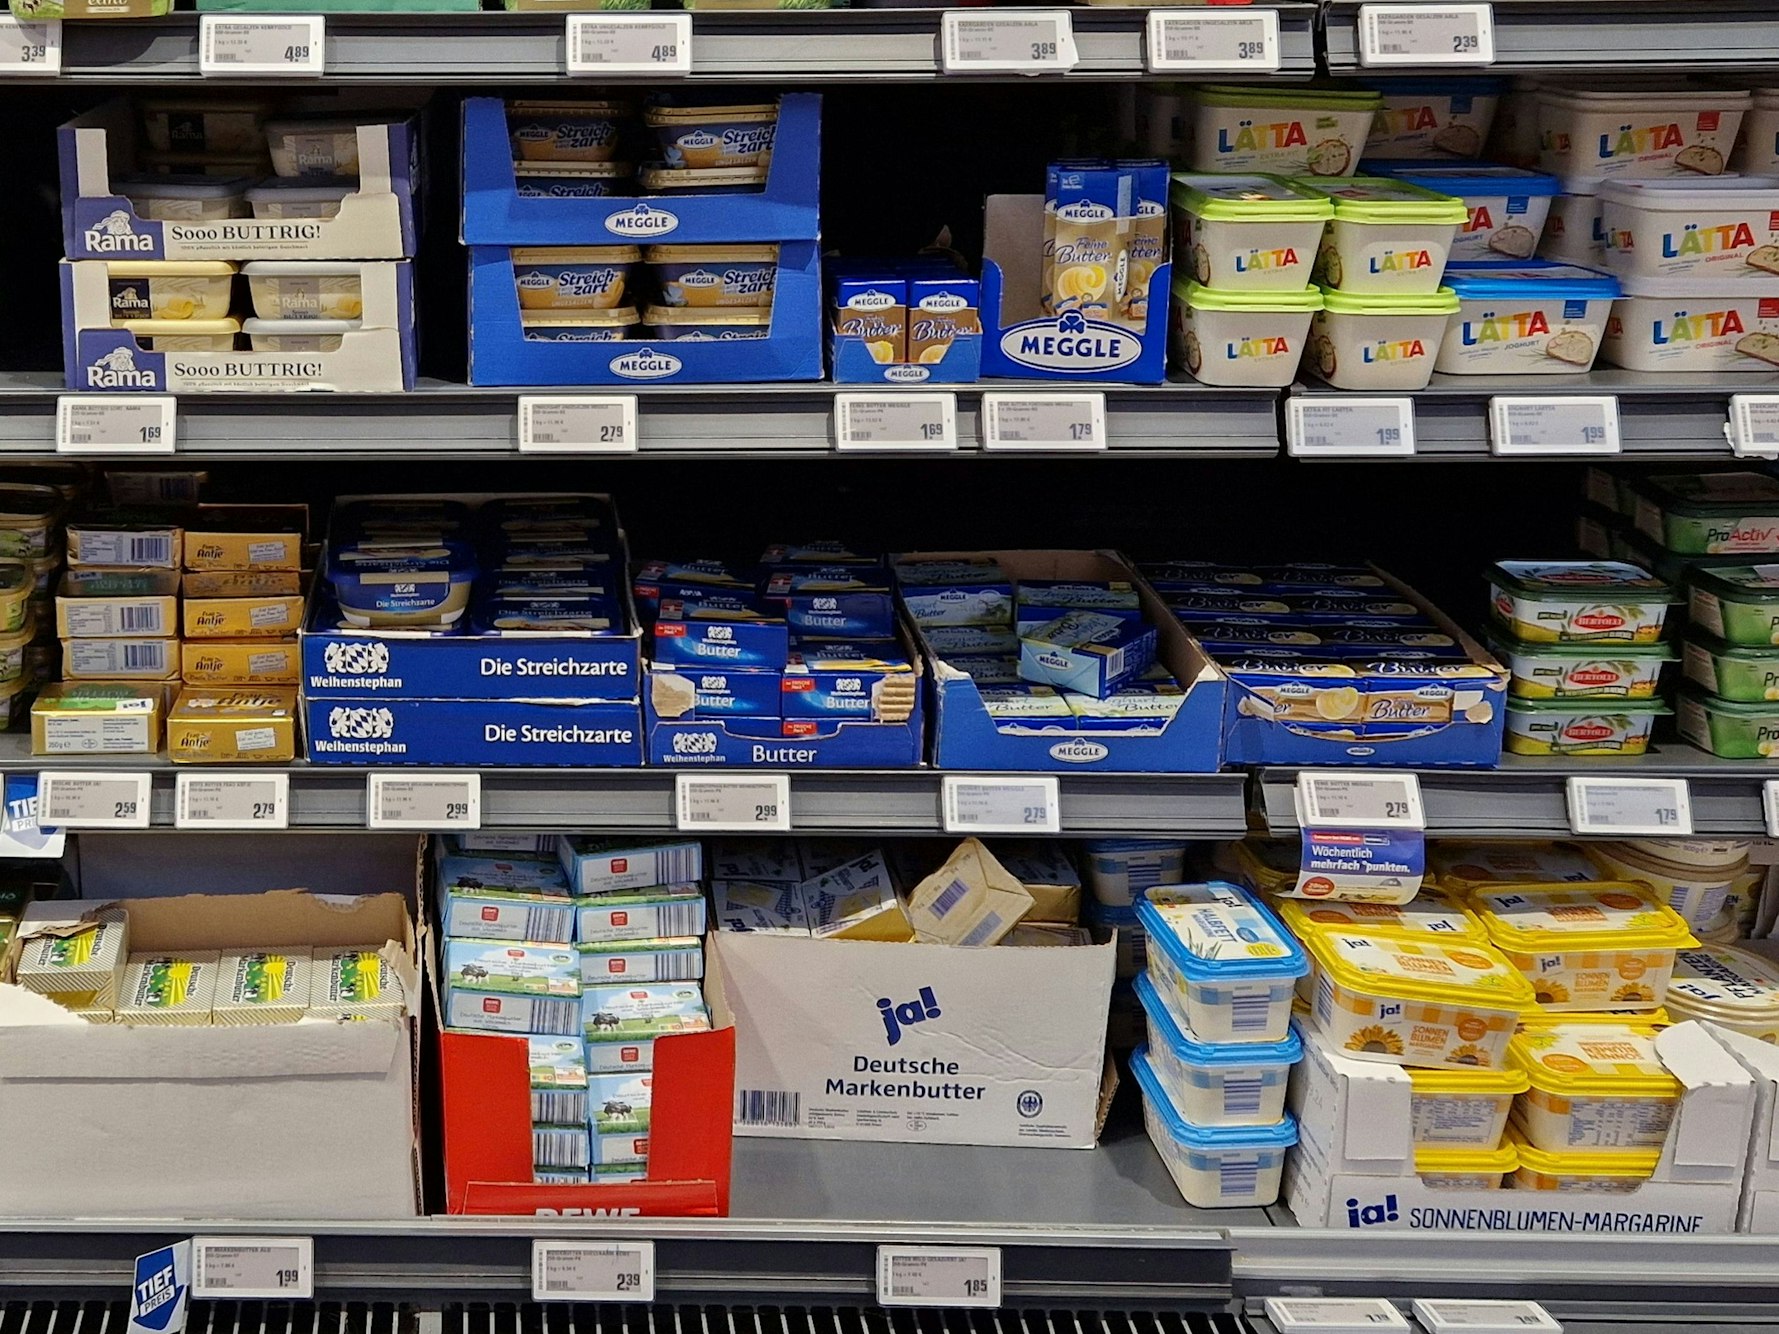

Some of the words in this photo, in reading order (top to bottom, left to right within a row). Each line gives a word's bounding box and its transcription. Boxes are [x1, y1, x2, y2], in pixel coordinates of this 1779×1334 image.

[1031, 42, 1057, 60] 3.89
[1238, 41, 1263, 59] 3.89
[1453, 35, 1478, 53] 2.39
[21, 46, 46, 62] 3.39
[284, 45, 310, 62] 4.89
[652, 45, 677, 62] 4.89
[682, 136, 716, 147] MEGGLE
[1218, 121, 1307, 153] LÄTTA
[1598, 124, 1684, 159] LÄTTA
[299, 154, 332, 165] Rama
[614, 216, 669, 229] MEGGLE
[1064, 209, 1105, 219] MEGGLE
[84, 229, 155, 253] Rama
[171, 225, 218, 241] Sooo
[223, 224, 321, 241] BUTTRIG!
[1662, 223, 1755, 259] LÄTTA
[1076, 237, 1108, 250] Feine
[1056, 245, 1113, 264] Butter
[1235, 248, 1299, 273] LÄTTA
[1369, 250, 1432, 274] LÄTTA
[1704, 252, 1744, 263] ORIGINAL
[520, 277, 550, 287] MEGGLE
[558, 268, 619, 286] Streich-
[684, 276, 715, 286] MEGGLE
[1117, 257, 1126, 295] MEGGLE
[573, 279, 610, 296] zart
[113, 297, 149, 309] Rama
[281, 297, 318, 309] Rama
[854, 297, 889, 306] MEGGLE
[926, 299, 960, 308] MEGGLE
[1462, 310, 1550, 346] LÄTTA
[1653, 310, 1744, 345] LÄTTA
[1021, 336, 1122, 359] MEGGLE
[1227, 337, 1289, 360] LÄTTA
[1363, 339, 1425, 363] LÄTTA
[1504, 339, 1540, 351] JOGHURT
[1695, 339, 1734, 350] ORIGINAL
[174, 363, 220, 377] Sooo
[225, 362, 322, 377] BUTTRIG!
[620, 359, 672, 372] MEGGLE
[87, 367, 156, 388] Rama
[139, 426, 161, 443] 1.69
[600, 425, 624, 442] 2.79
[920, 423, 943, 440] 1.69
[1069, 423, 1092, 440] 1.79
[1376, 428, 1400, 445] 1.99
[1581, 426, 1605, 444] 1.99
[196, 549, 224, 560] Antje
[375, 600, 389, 608] Die
[390, 599, 435, 608] Streichzarte
[196, 616, 224, 627] Antje
[804, 615, 847, 627] Butter
[1578, 616, 1622, 626] BERTOLLI
[697, 643, 742, 657] Butter
[195, 662, 223, 672] Antje
[480, 659, 512, 676] Die
[516, 658, 628, 677] Streichzarte
[1039, 655, 1069, 668] MEGGLE
[310, 675, 403, 691] Weihenstephan
[1572, 672, 1617, 681] BERTOLLI
[1279, 686, 1311, 694] MEGGLE
[1418, 689, 1449, 697] MEGGLE
[826, 696, 871, 708] Butter
[995, 702, 1051, 712] Butter
[1371, 699, 1429, 719] Butter
[484, 724, 516, 743] Die
[520, 724, 633, 744] Streichzarte
[1568, 727, 1613, 737] BERTOLLI
[181, 737, 209, 748] Antje
[315, 740, 407, 755] Weihenstephan
[663, 754, 726, 763] Weihenstephan
[752, 744, 817, 763] Butter
[1057, 747, 1100, 756] MEGGLE
[115, 801, 137, 818] 2.59
[253, 802, 275, 819] 2.79
[446, 803, 468, 819] 2.99
[755, 805, 777, 820] 2.99
[1023, 807, 1046, 823] 2.79
[1385, 801, 1409, 818] 2.79
[1654, 807, 1677, 825] 1.79
[1311, 845, 1373, 859] Wöchentlich
[1310, 859, 1360, 871] mehrfach
[1212, 896, 1243, 908] ja!
[1344, 937, 1372, 950] ja!
[1540, 955, 1562, 973] ja!
[1575, 972, 1611, 980] SONNEN
[1575, 979, 1610, 988] BLUMEN
[1676, 983, 1723, 1000] ja!
[875, 985, 942, 1047] ja!
[1380, 1003, 1401, 1020] ja!
[1410, 1031, 1446, 1044] BLUMEN
[1412, 1024, 1450, 1035] SONNEN
[853, 1055, 960, 1076] Deutsche
[825, 1079, 986, 1101] Markenbutter
[1345, 1194, 1399, 1228] ja!
[1409, 1208, 1704, 1233] SONNENBLUMEN-MARGARINE
[137, 1264, 173, 1302] TIEF
[275, 1269, 299, 1288] 1.99
[616, 1273, 641, 1291] 2.39
[963, 1279, 987, 1297] 1.85
[143, 1289, 172, 1313] PREIS
